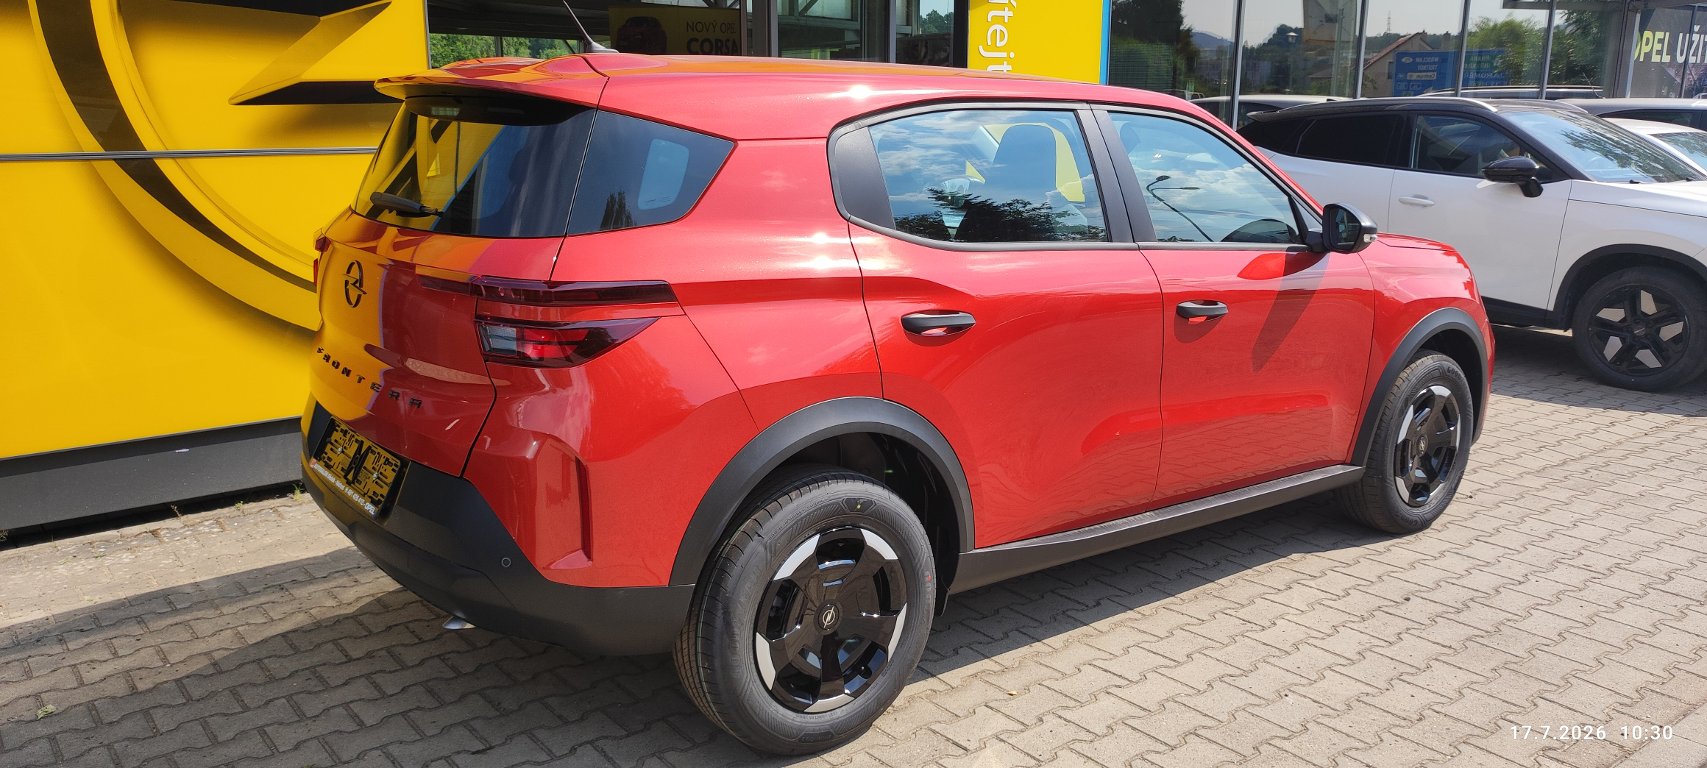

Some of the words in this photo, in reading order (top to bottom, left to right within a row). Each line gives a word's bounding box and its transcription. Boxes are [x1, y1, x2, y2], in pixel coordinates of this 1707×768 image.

[686, 19, 717, 33] NOVÝ
[719, 21, 737, 34] OPEL
[686, 37, 739, 55] CORSA
[316, 346, 423, 409] FRONTERA
